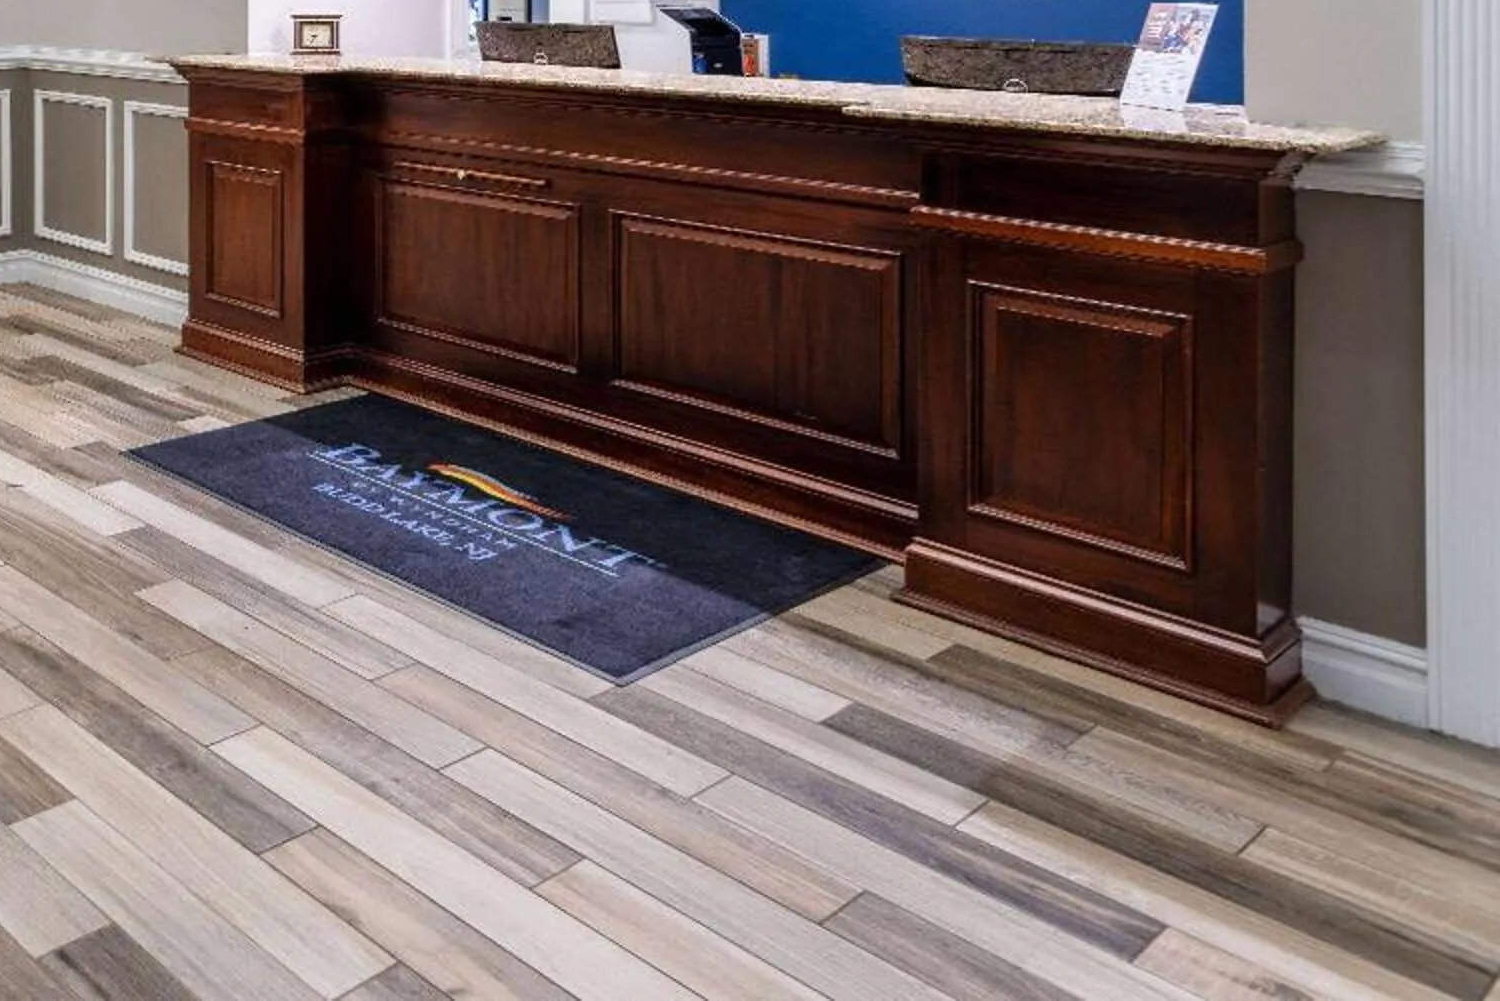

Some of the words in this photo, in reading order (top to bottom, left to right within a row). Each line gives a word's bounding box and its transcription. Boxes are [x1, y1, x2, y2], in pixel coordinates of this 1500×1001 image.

[312, 482, 385, 514] BUDD
[455, 542, 499, 561] NJ
[314, 443, 656, 568] BAYMONT
